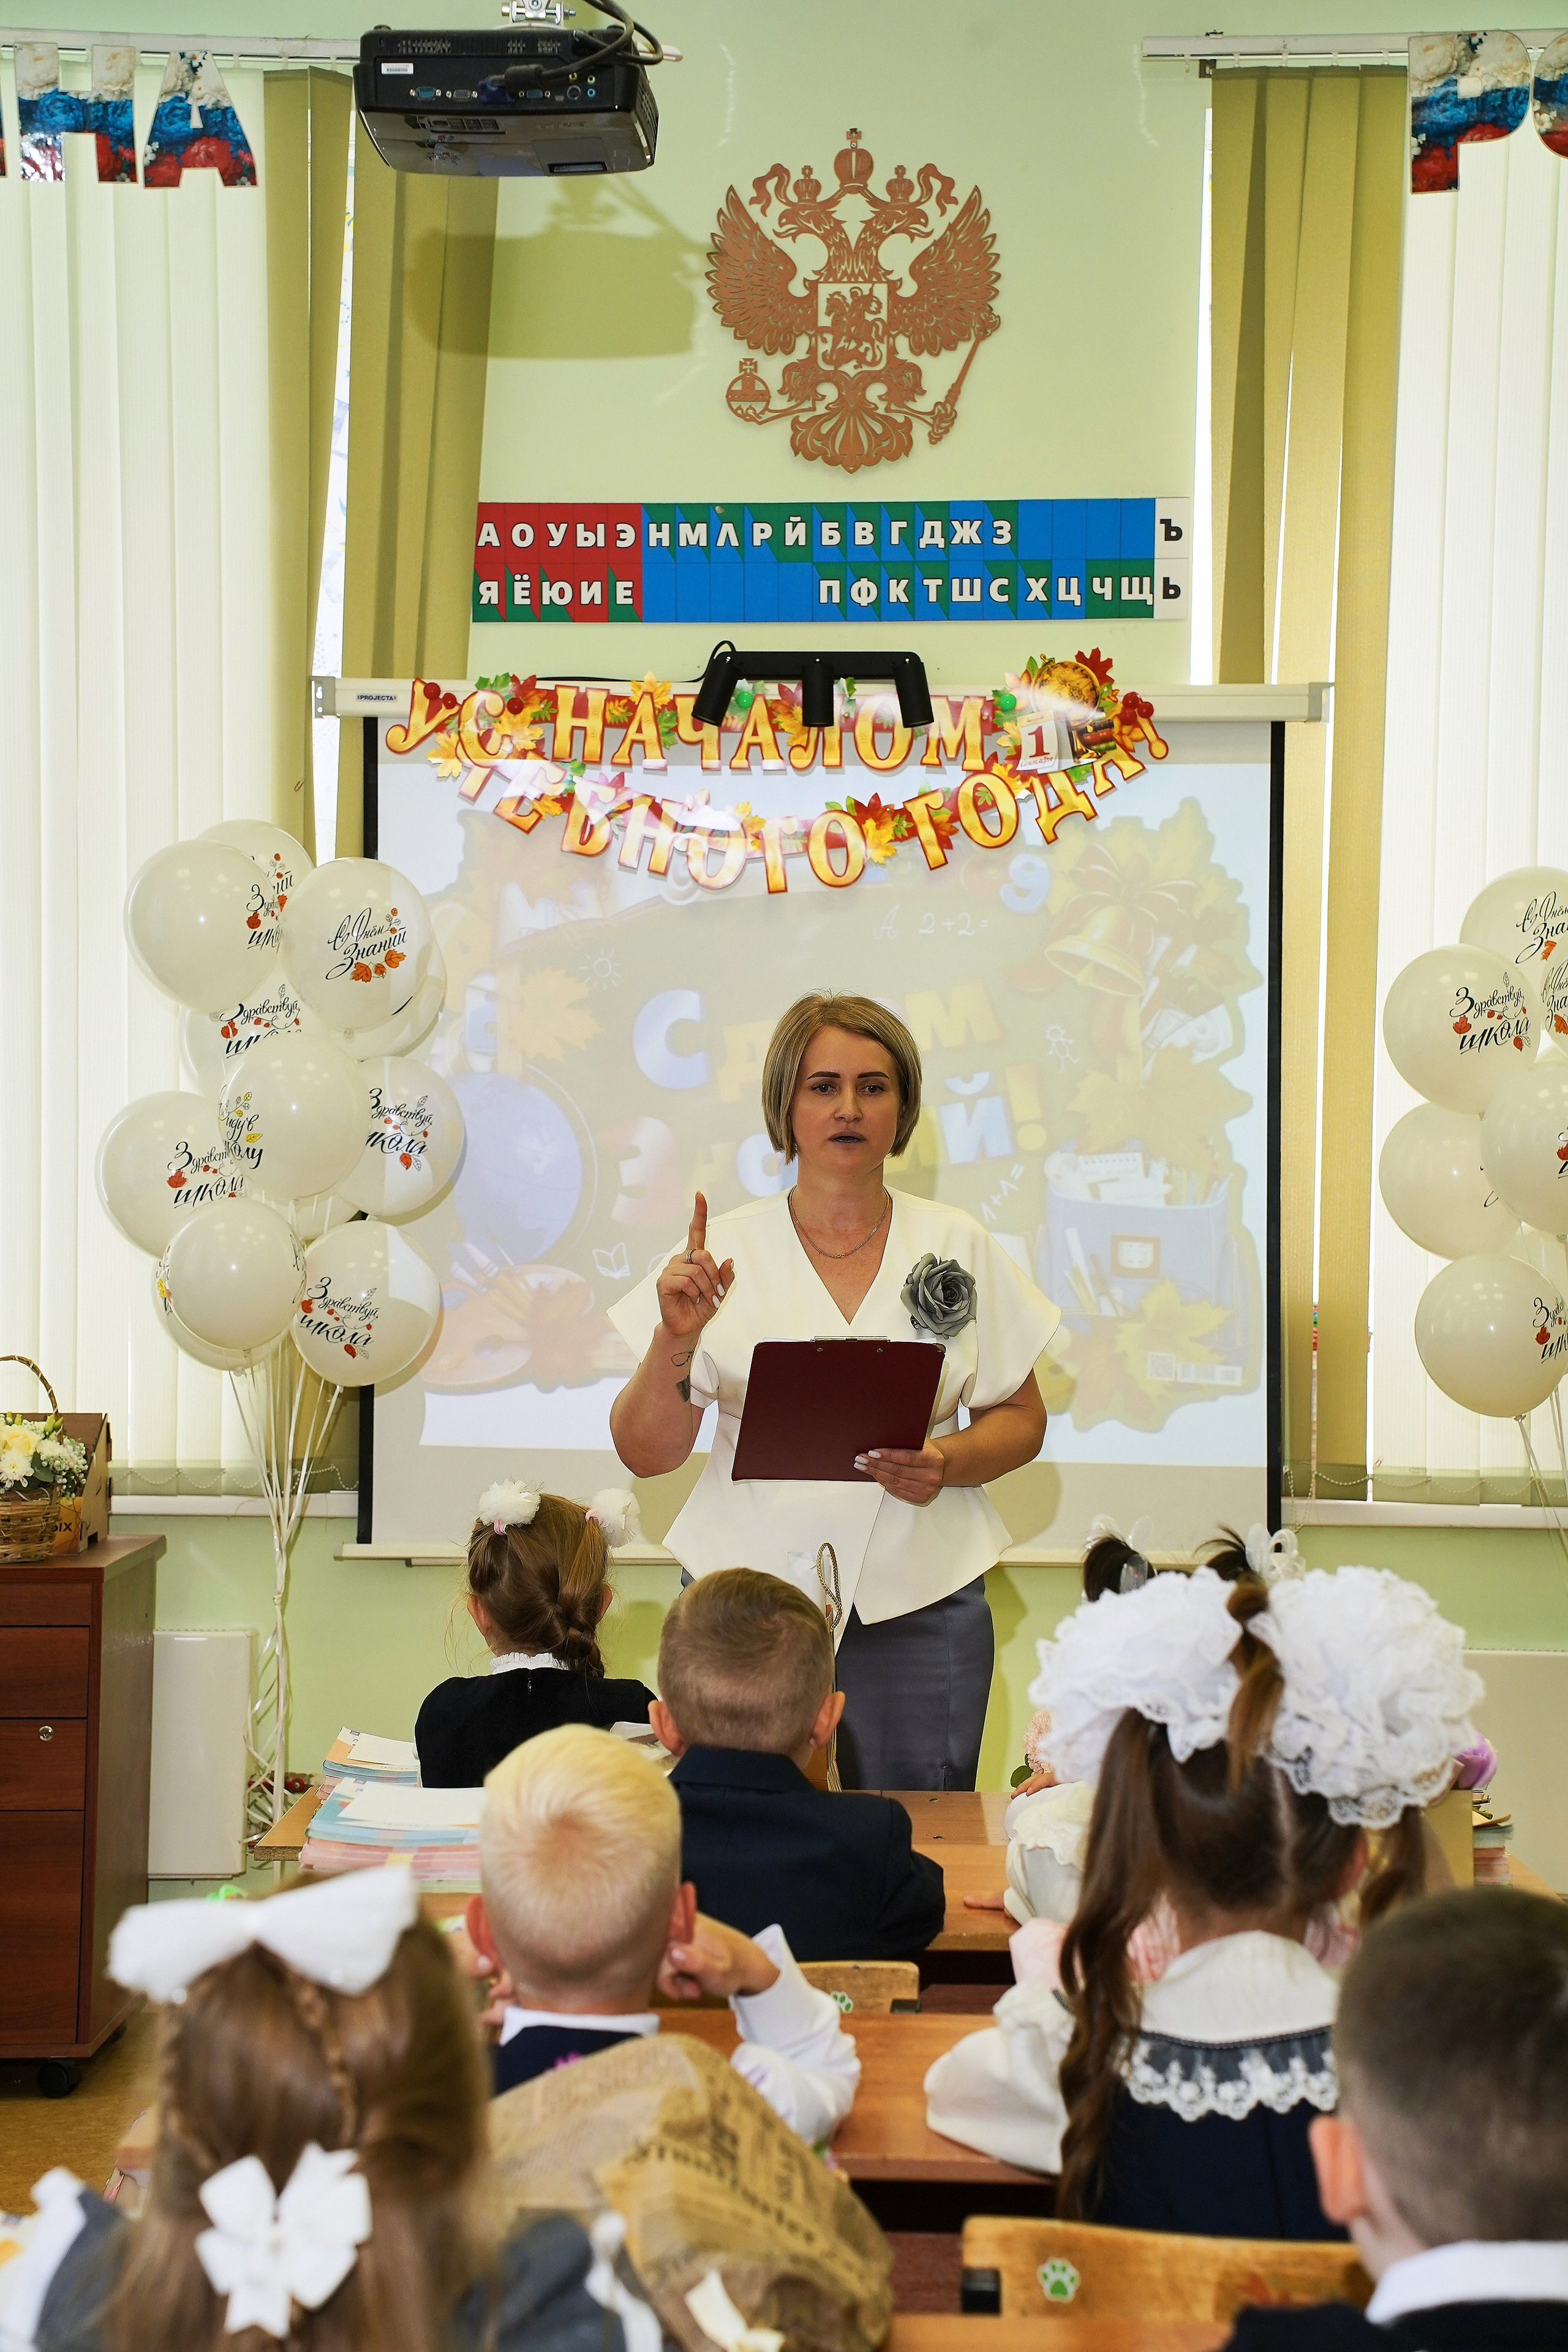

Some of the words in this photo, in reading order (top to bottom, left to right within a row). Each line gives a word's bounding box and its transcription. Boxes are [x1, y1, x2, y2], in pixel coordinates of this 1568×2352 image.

[0, 42, 258, 189] НА
[1027, 725, 1050, 758] 1
[325, 926, 407, 980] Знаний
[1515, 922, 1568, 964] Зна
[1545, 995, 1568, 1032] Зна
[1460, 1017, 1531, 1055] школа
[300, 1314, 374, 1346] школа
